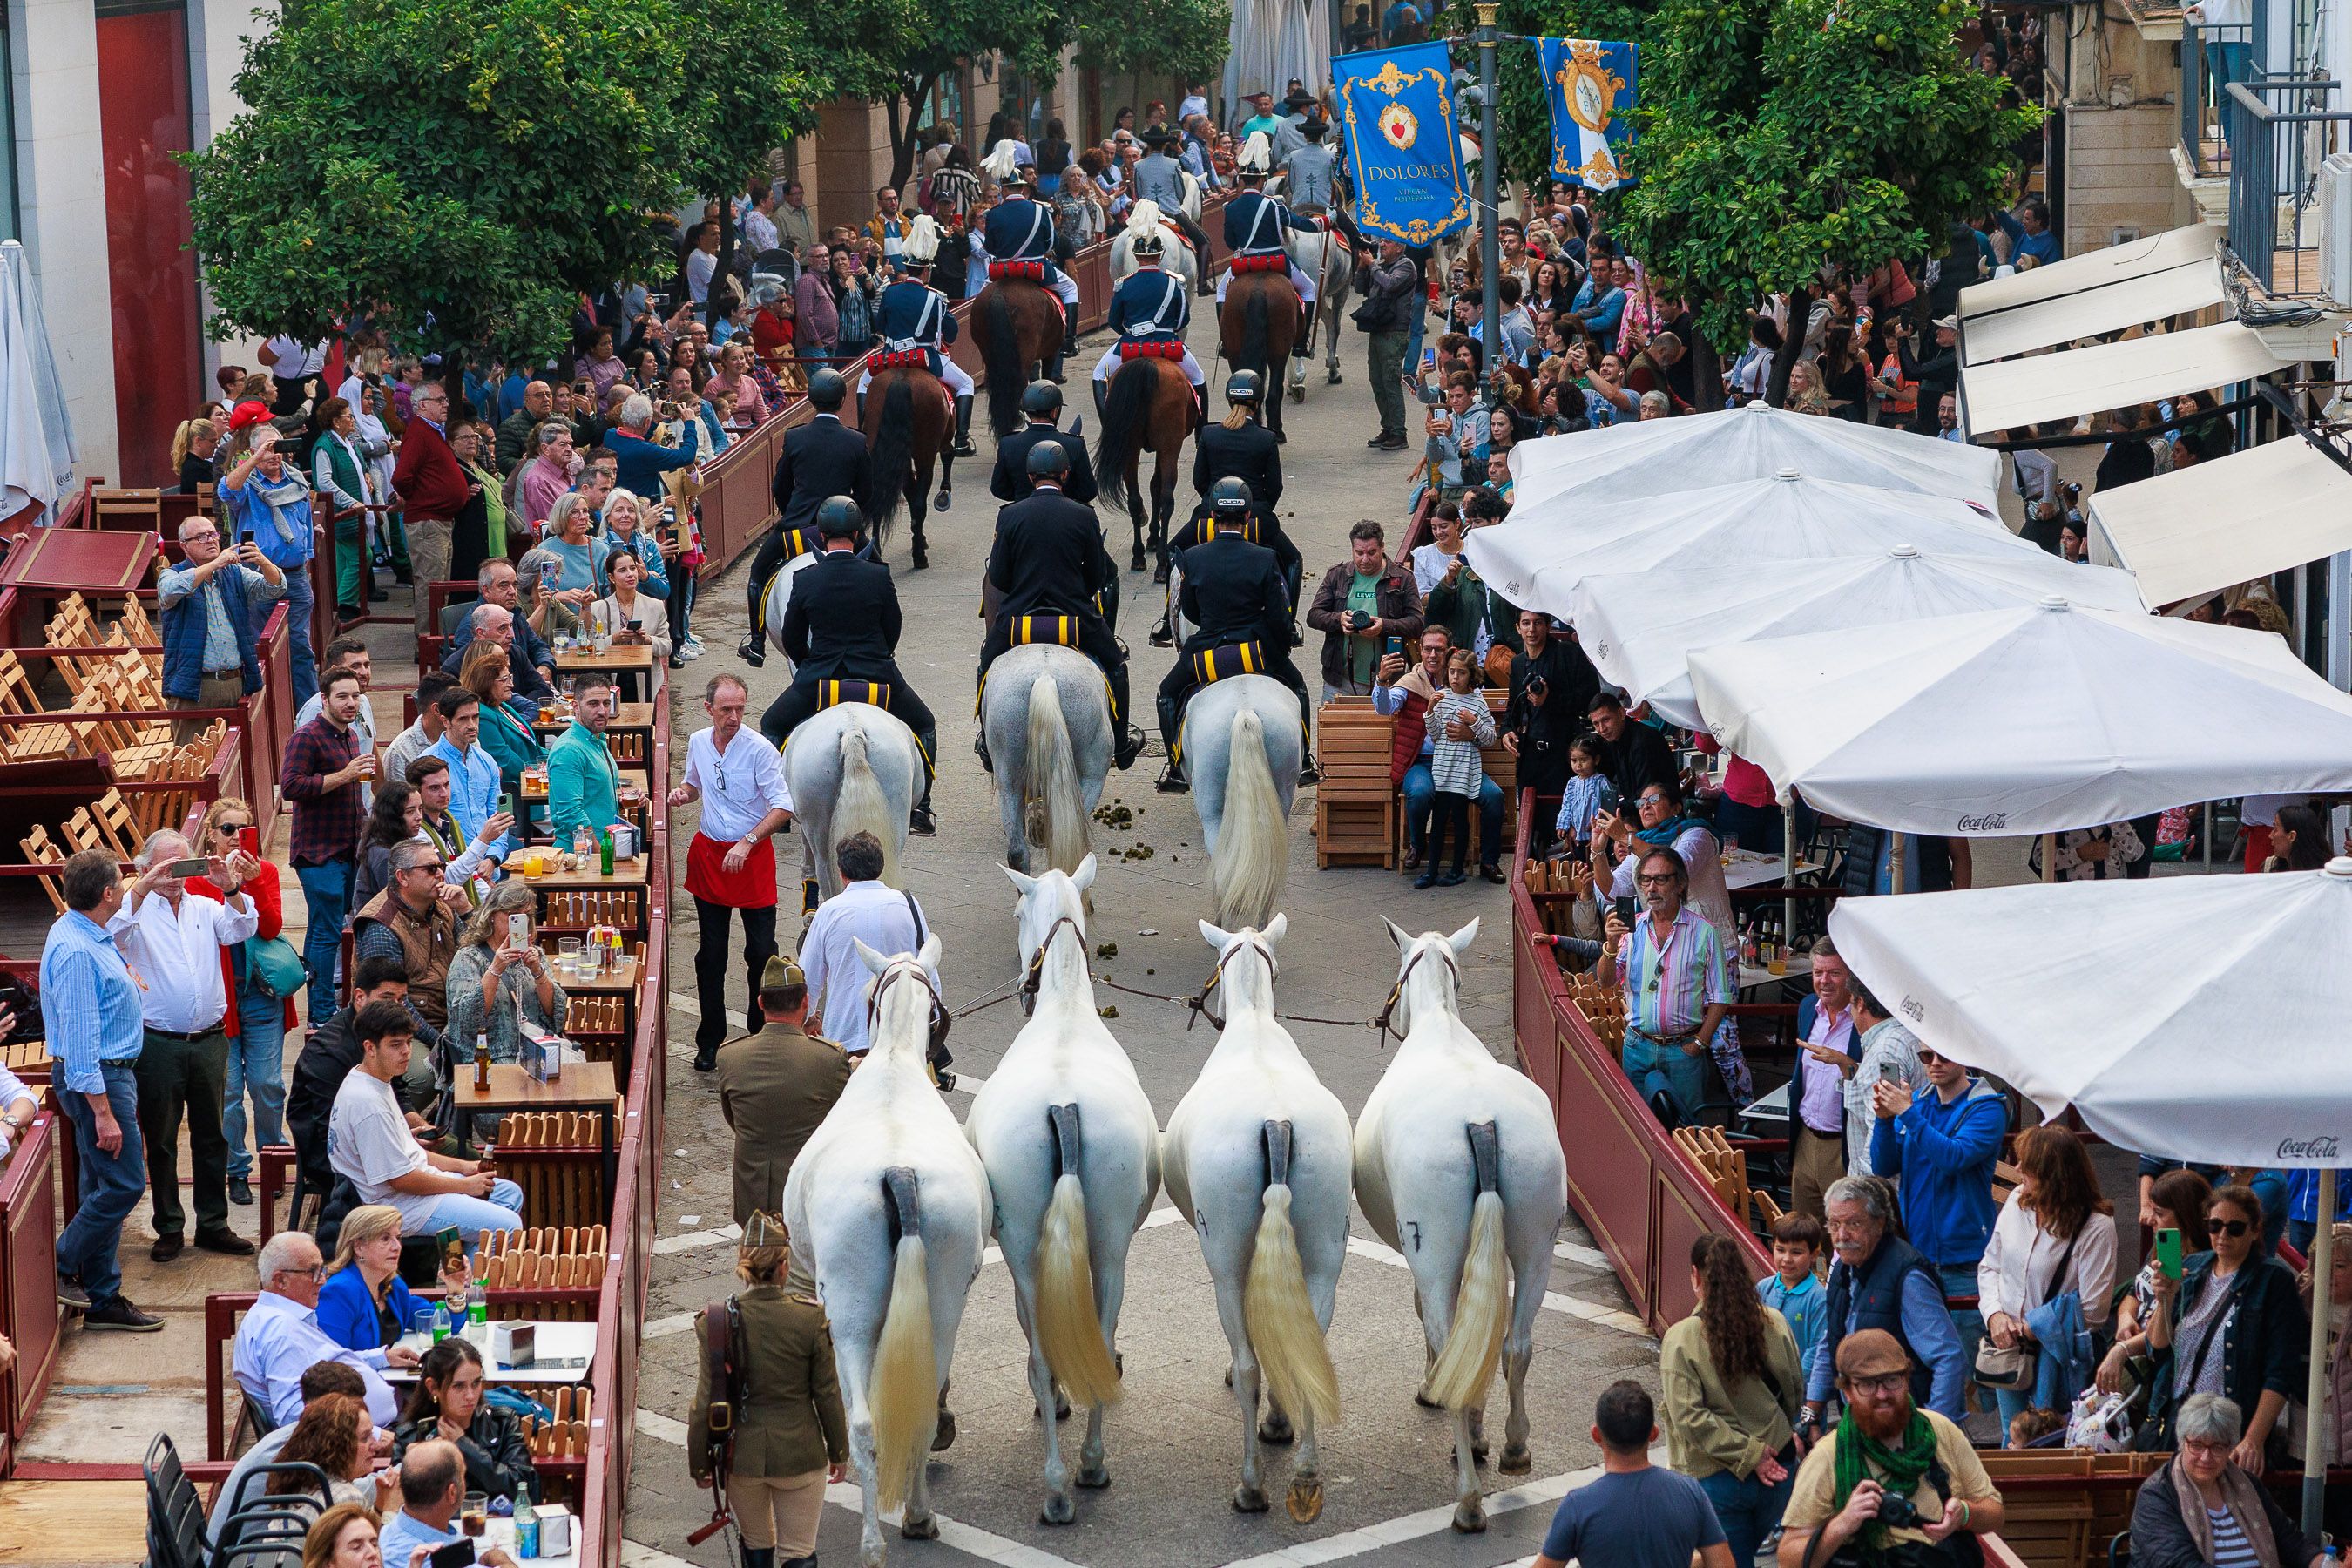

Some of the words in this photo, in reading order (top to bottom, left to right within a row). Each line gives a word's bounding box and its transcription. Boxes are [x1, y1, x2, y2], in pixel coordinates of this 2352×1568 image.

[1369, 163, 1450, 181] DOLORES
[1394, 194, 1436, 203] PODEROSA
[1957, 813, 2007, 832] Coca-Cola
[2277, 1136, 2341, 1159] Coca-Cola
